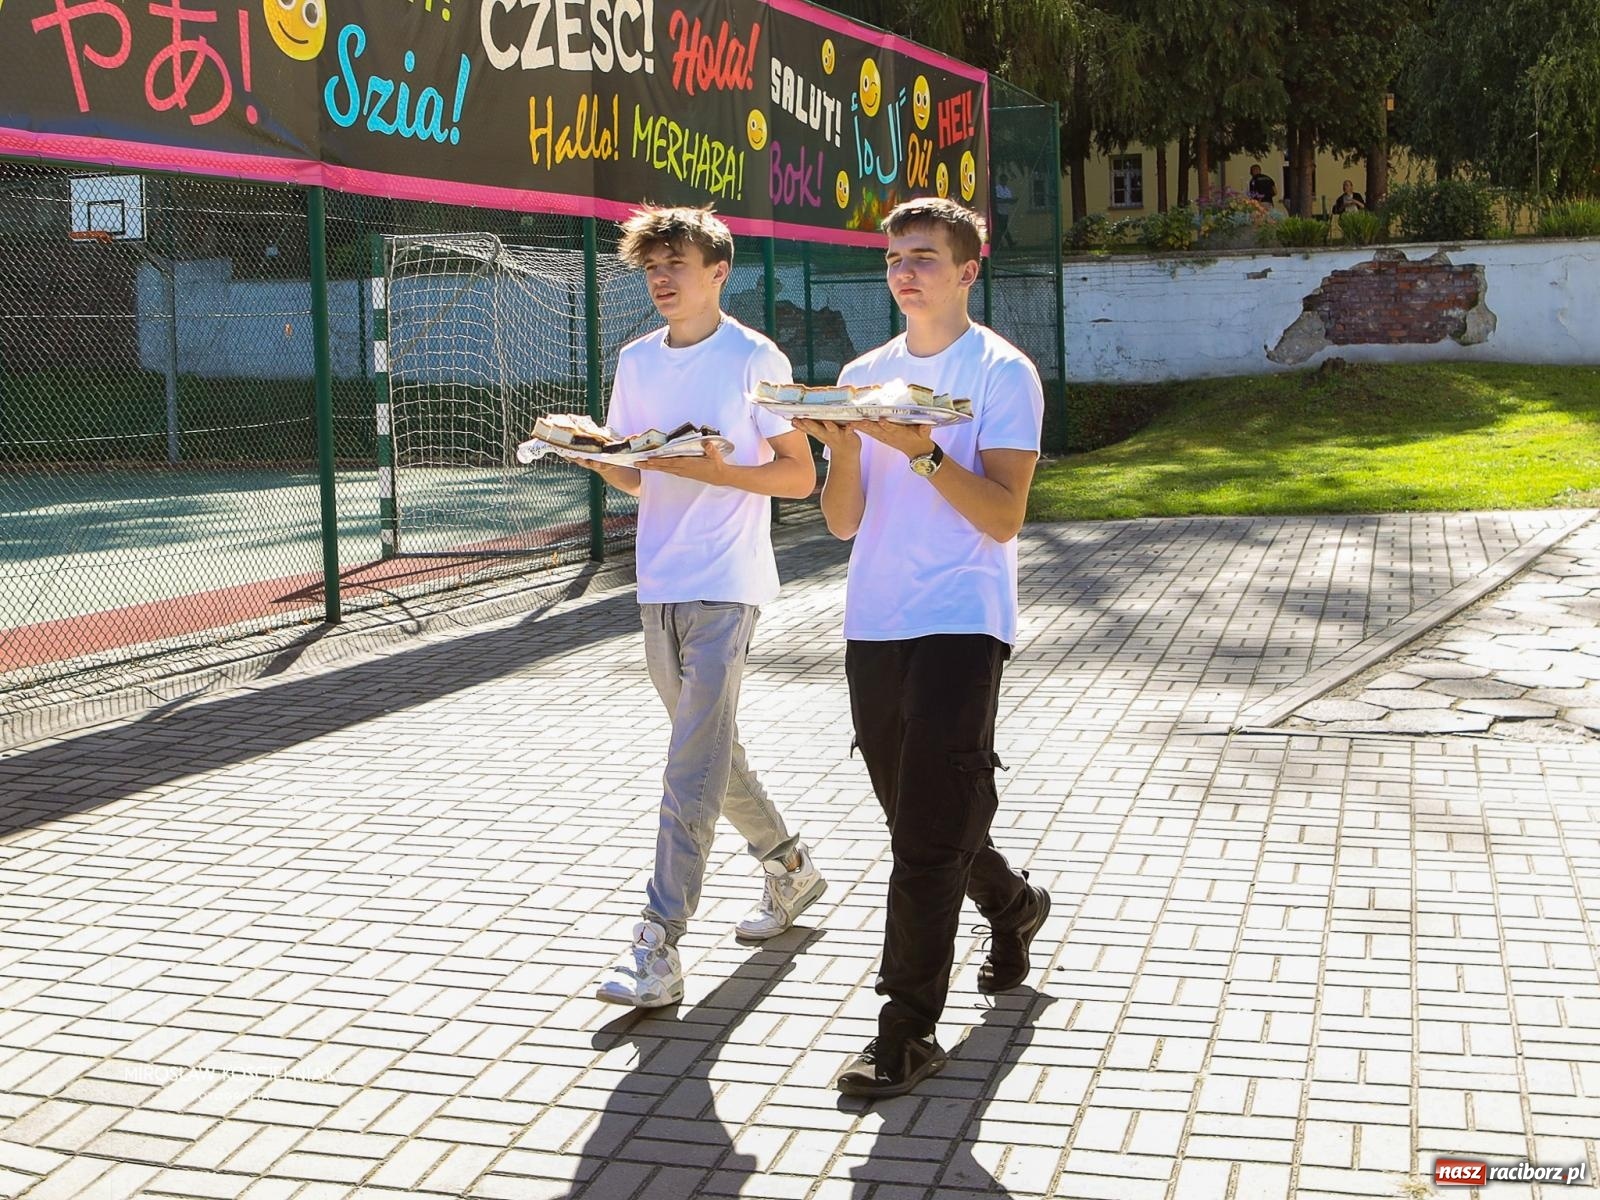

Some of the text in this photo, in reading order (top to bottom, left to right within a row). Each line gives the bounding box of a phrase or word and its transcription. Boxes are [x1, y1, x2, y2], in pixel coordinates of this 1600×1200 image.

[324, 23, 471, 146] Szia!
[669, 9, 761, 97] Hola!
[528, 93, 619, 171] Hallo!
[770, 56, 842, 149] SALUT!
[937, 89, 975, 150] HEI!
[631, 103, 745, 201] MERHABA!
[768, 140, 824, 208] Bok!
